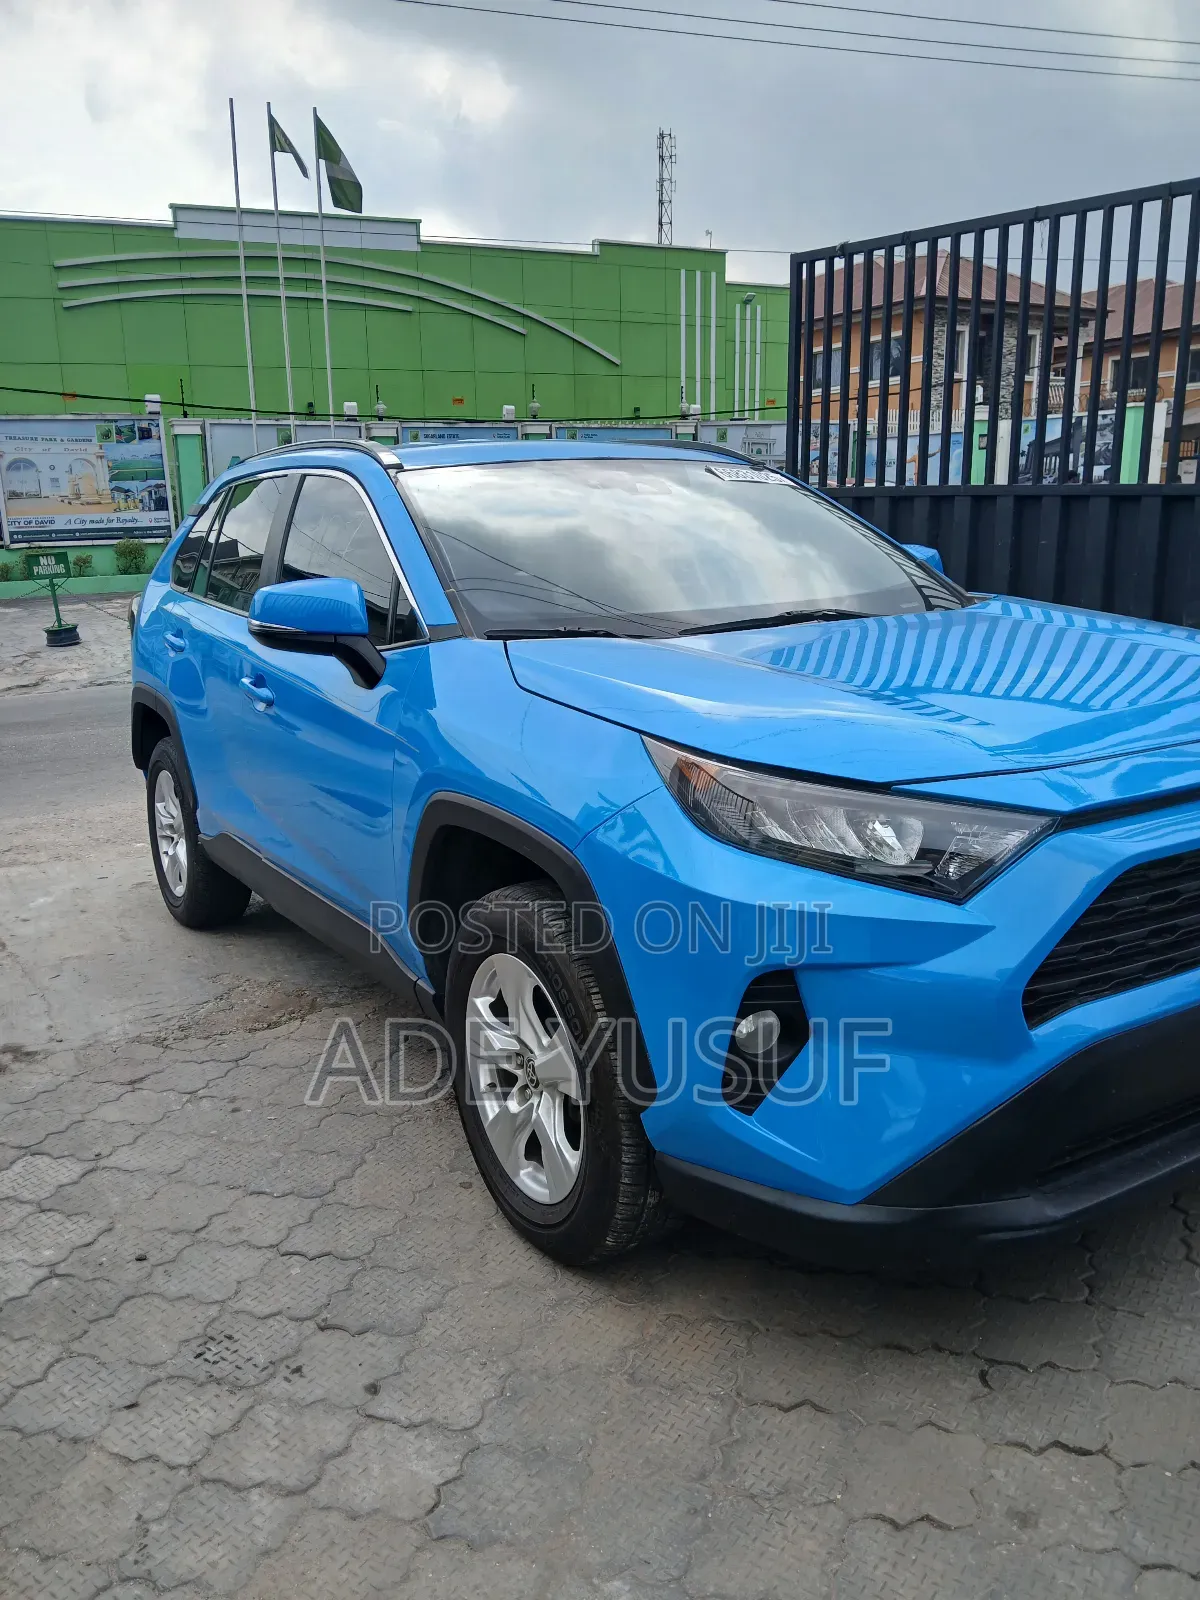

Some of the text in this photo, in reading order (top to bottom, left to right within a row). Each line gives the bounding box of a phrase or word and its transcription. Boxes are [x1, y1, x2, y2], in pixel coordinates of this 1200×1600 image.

[73, 518, 87, 526] City
[88, 517, 104, 525] made
[104, 516, 115, 525] for
[38, 556, 56, 566] NO
[32, 563, 66, 576] PARKING
